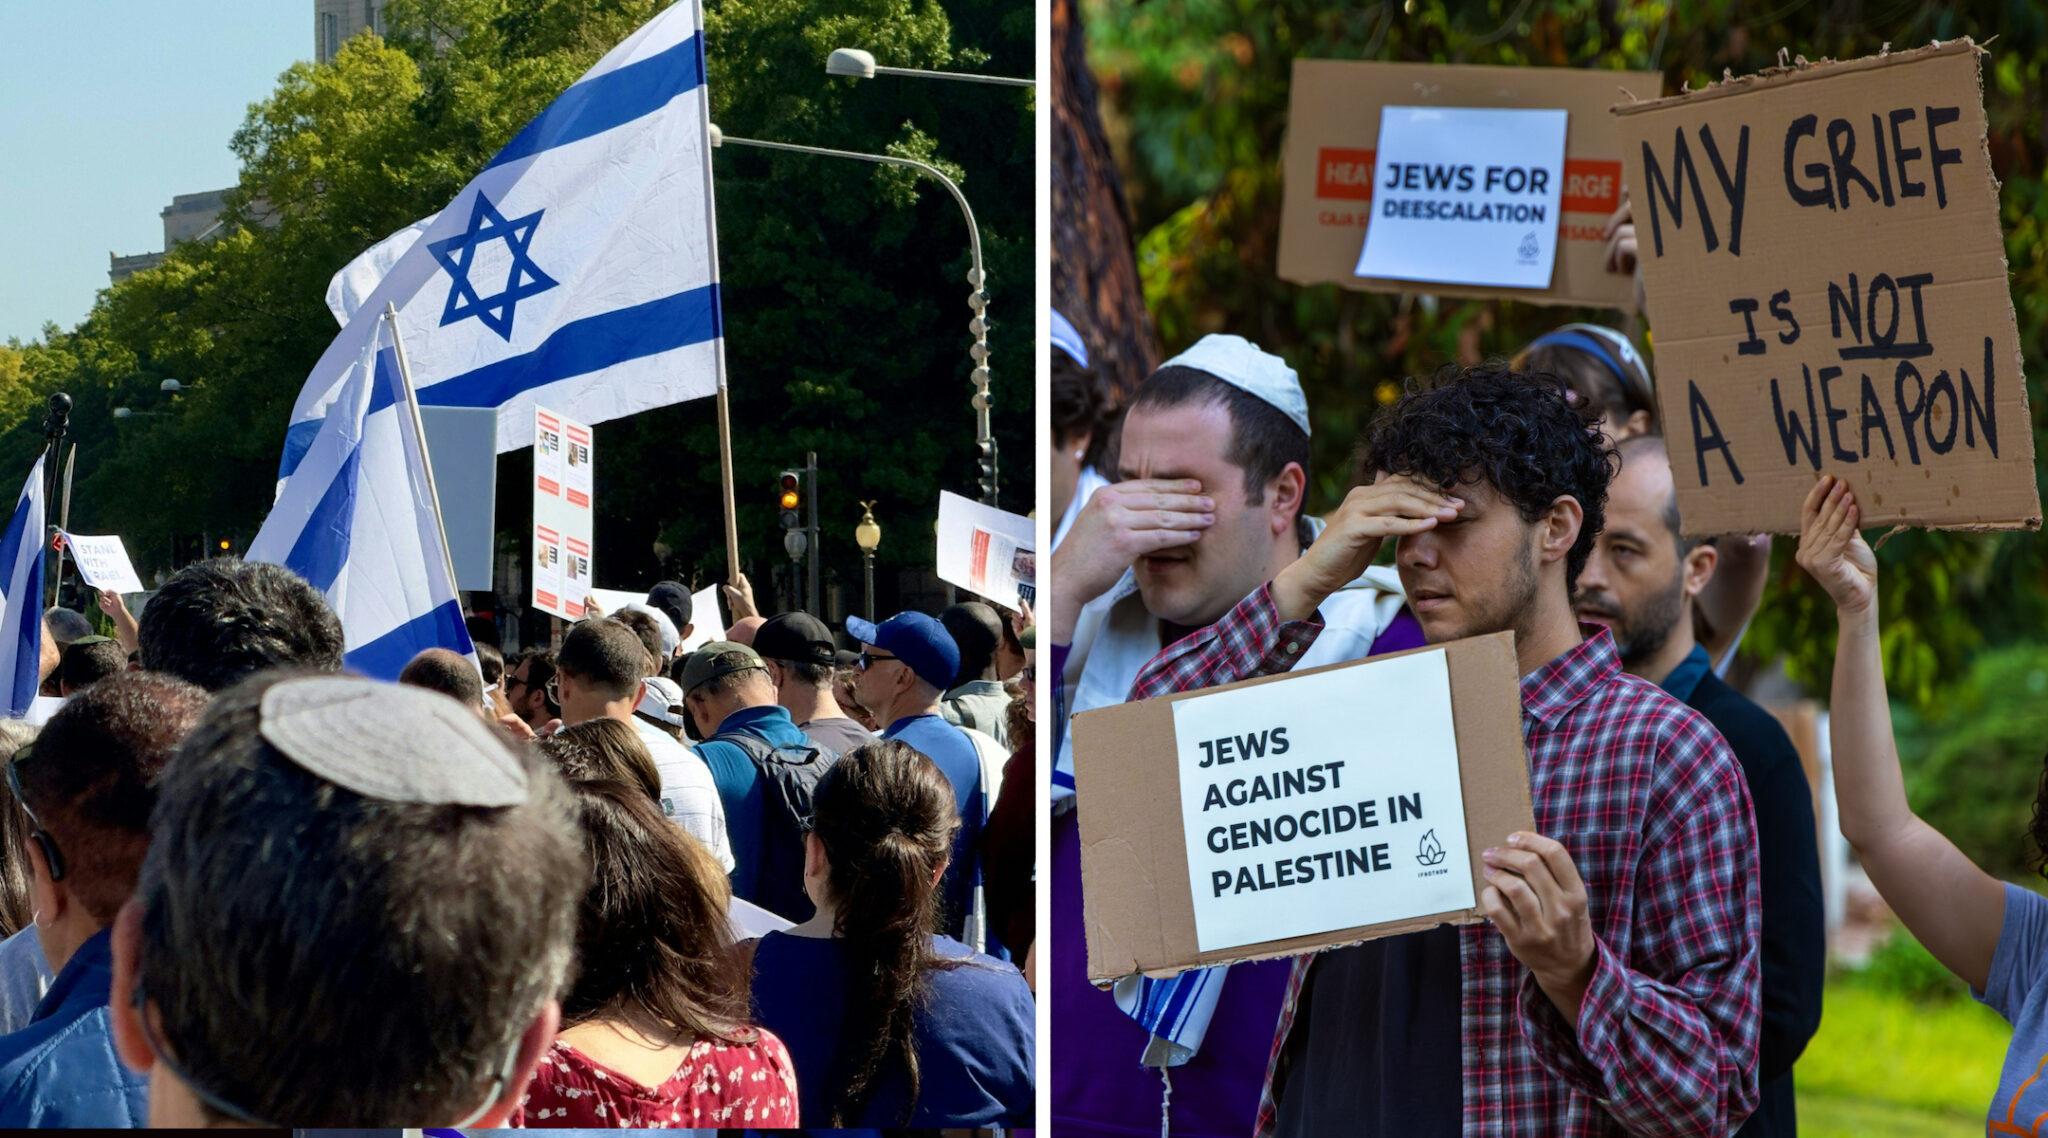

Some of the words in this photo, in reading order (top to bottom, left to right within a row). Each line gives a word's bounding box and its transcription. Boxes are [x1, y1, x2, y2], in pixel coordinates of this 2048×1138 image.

[1384, 163, 1475, 192] JEWS
[1484, 166, 1549, 194] FOR
[1641, 123, 1750, 258] MY
[1783, 105, 1962, 212] GRIEF
[1382, 199, 1546, 223] DEESCALATION
[1729, 289, 1800, 355] IS
[1828, 272, 1934, 350] NOT
[1688, 379, 1745, 487] A
[1770, 337, 1998, 472] WEAPON
[1199, 727, 1290, 768] JEWS
[1203, 761, 1345, 811] AGAINST
[1207, 800, 1379, 853] GENOCIDE
[1388, 793, 1423, 823] IN
[1212, 843, 1392, 898] PALESTINE
